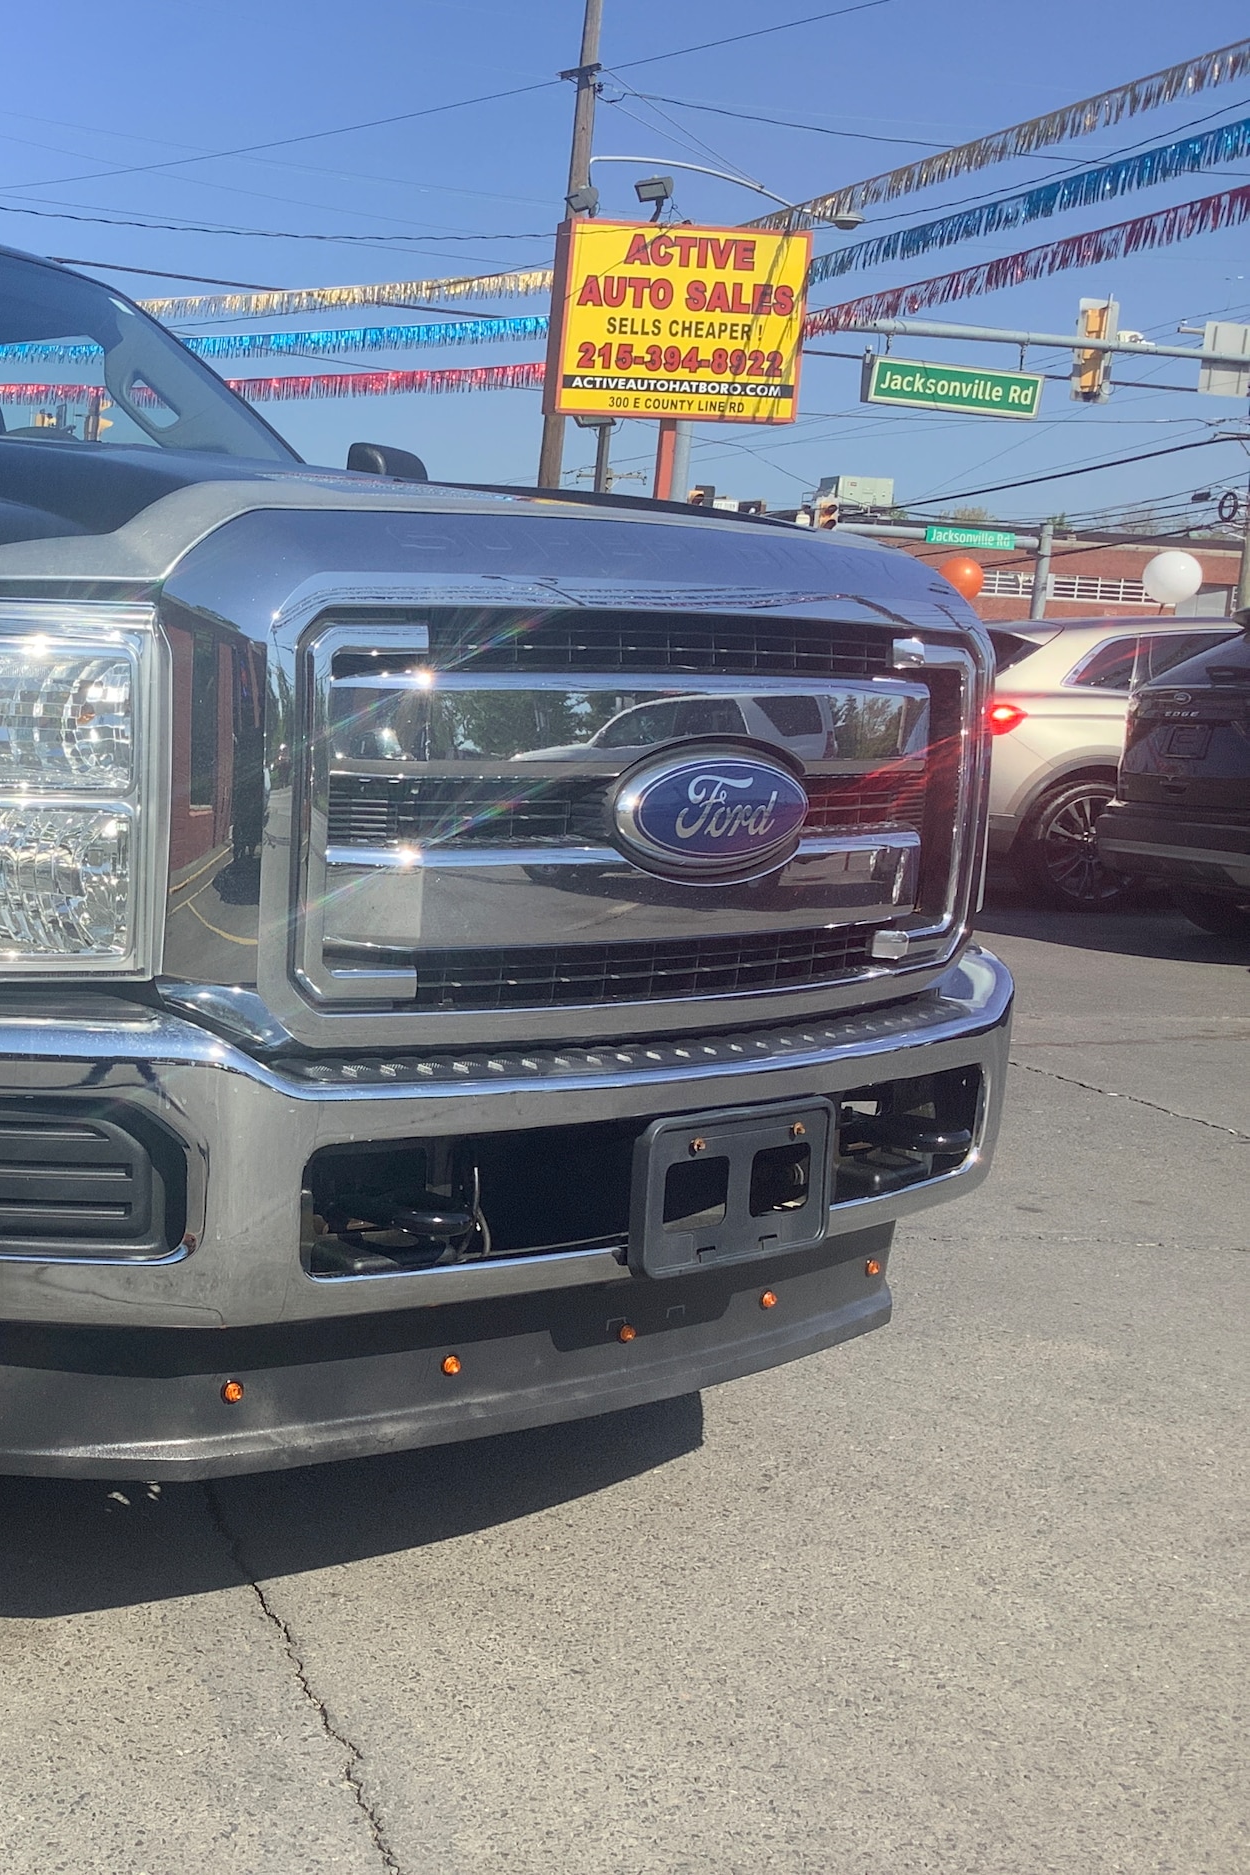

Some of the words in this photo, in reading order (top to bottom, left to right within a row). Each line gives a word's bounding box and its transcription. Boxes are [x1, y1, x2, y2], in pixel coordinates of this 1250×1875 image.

[623, 233, 757, 272] ACTIVE
[576, 274, 674, 310] AUTO
[685, 279, 795, 317] SALES
[606, 316, 662, 337] SELLS
[669, 319, 751, 341] CHEAPER
[576, 341, 784, 378] 215-394-8922
[571, 375, 781, 397] ACTIVEAUTOHATBORO.COM
[608, 395, 630, 409] 300
[633, 397, 641, 409] E
[644, 398, 695, 412] COUNTY
[698, 400, 725, 413] LINE
[728, 401, 745, 413] RD
[879, 370, 1003, 403] Jacksonville
[1008, 384, 1034, 406] Rd
[931, 528, 994, 546] Jacksonville
[996, 535, 1011, 547] Rd
[675, 774, 778, 838] Ford
